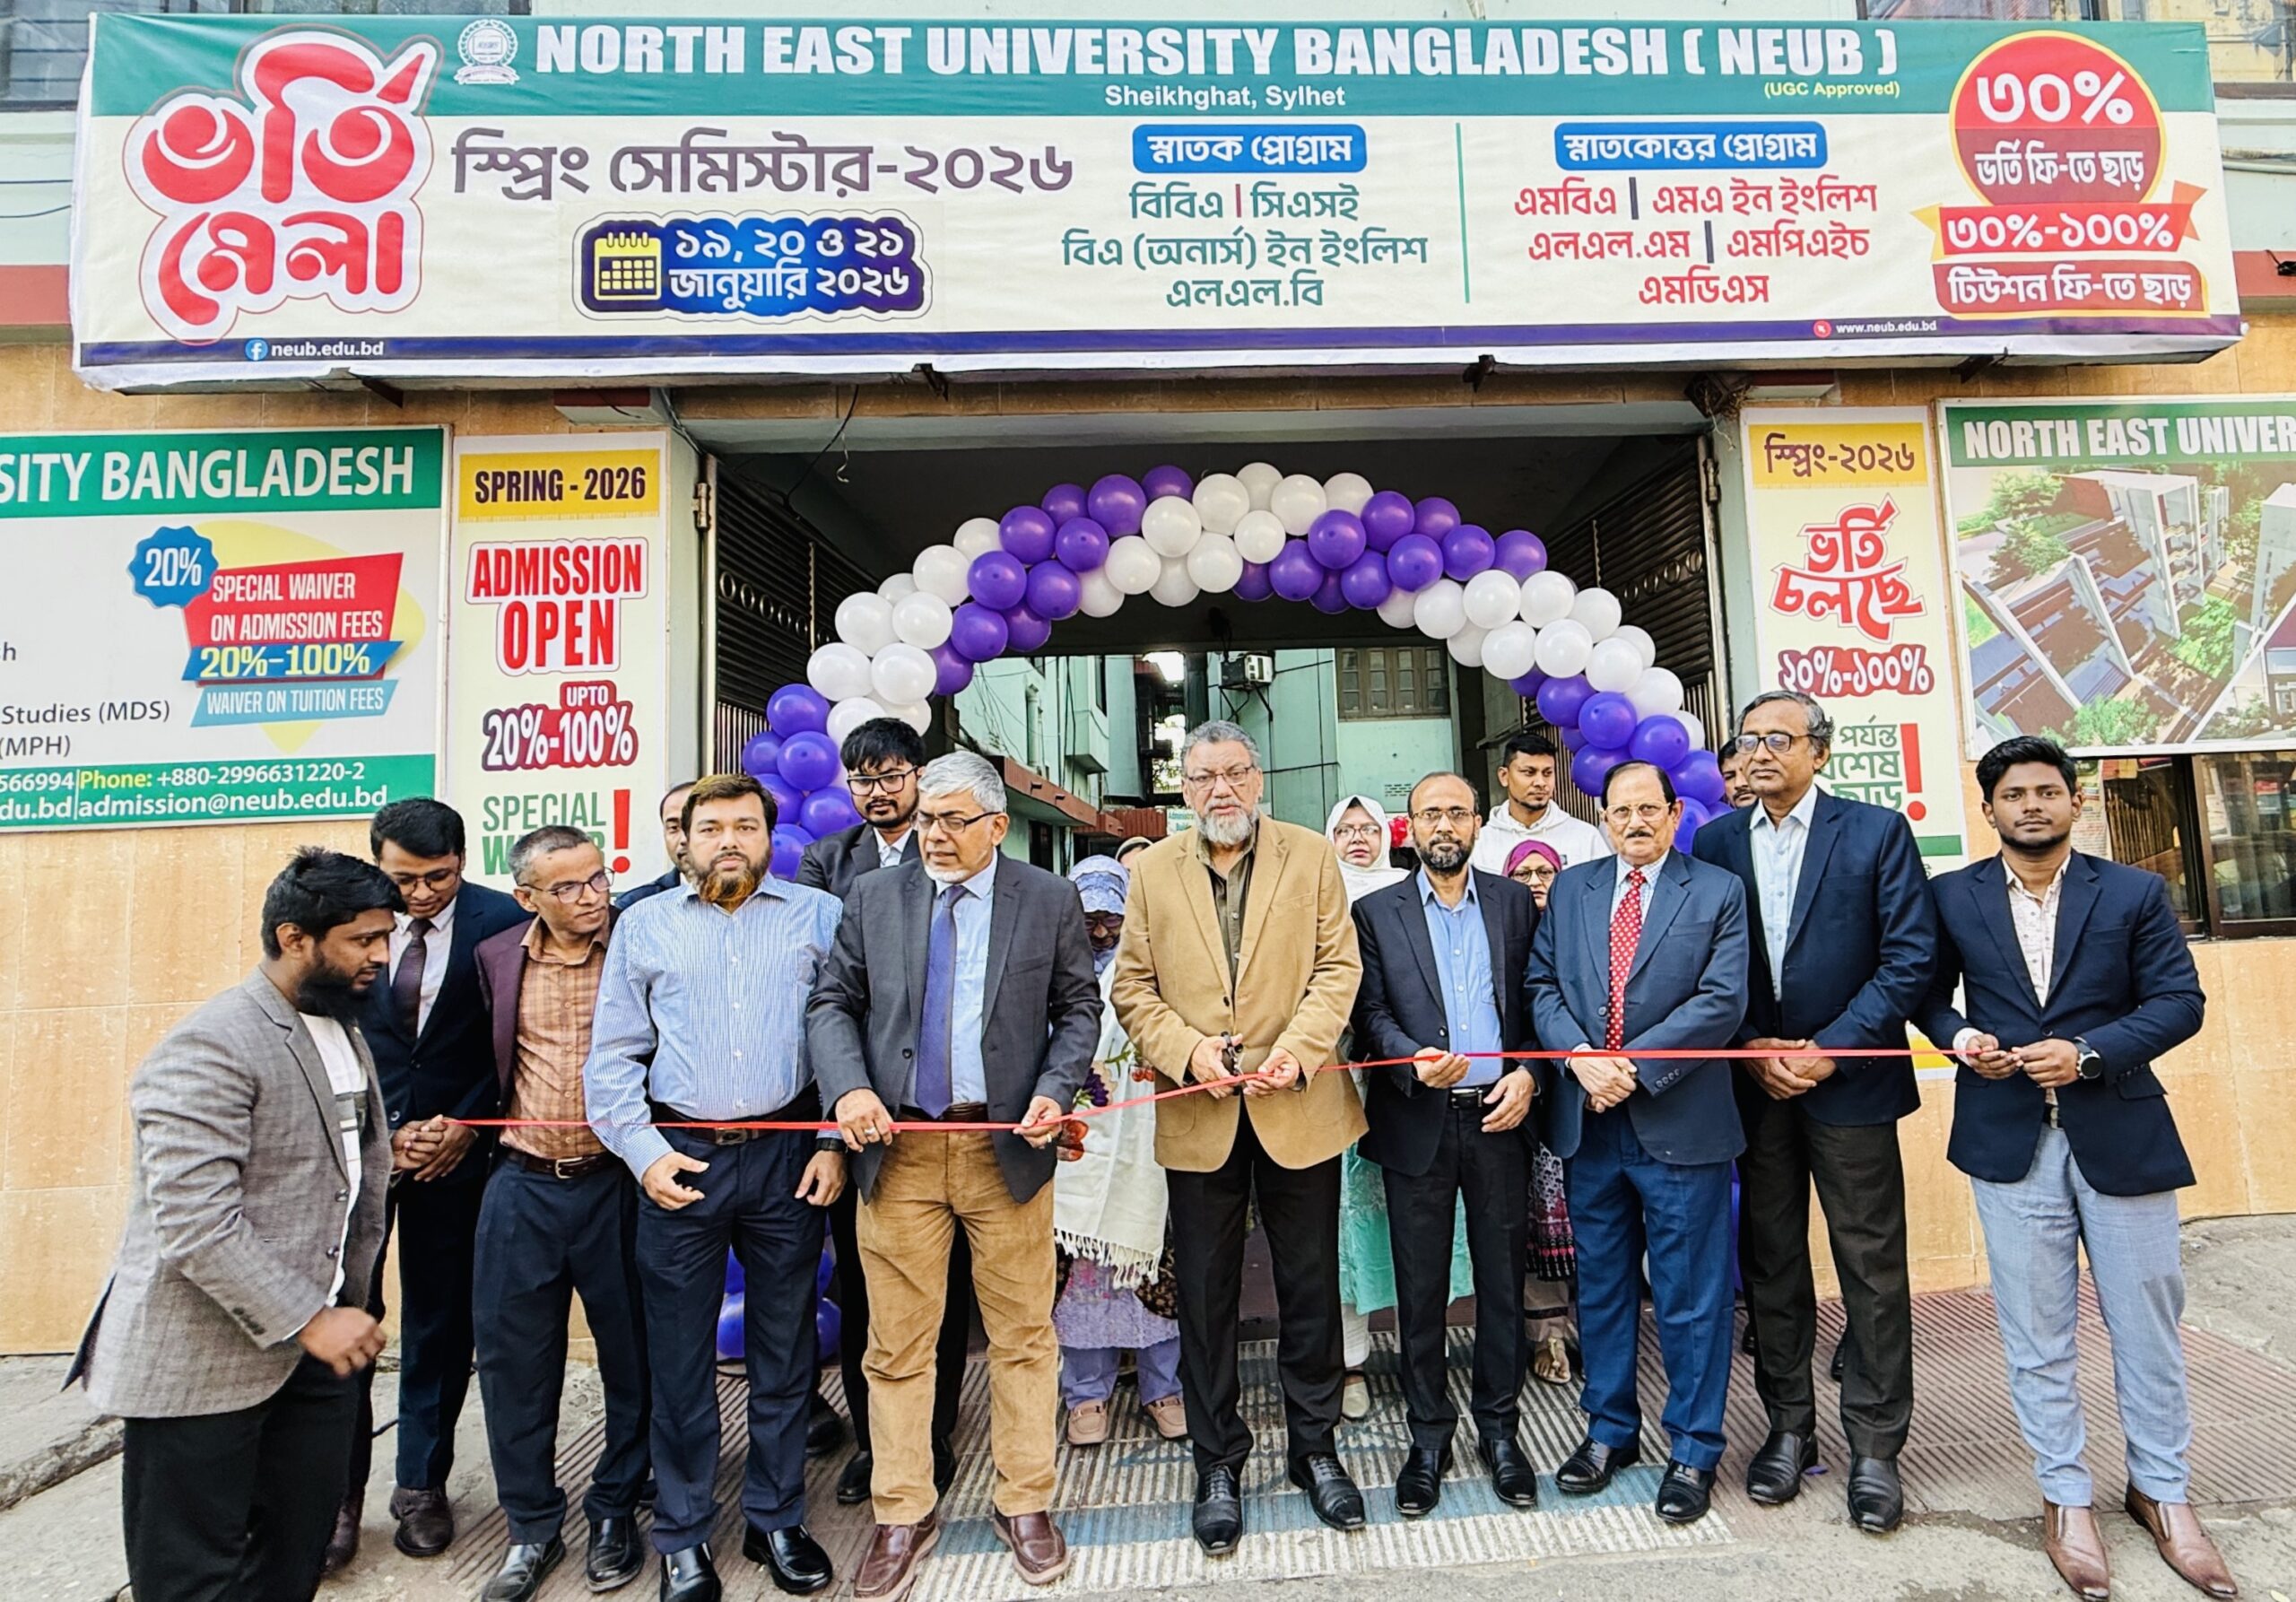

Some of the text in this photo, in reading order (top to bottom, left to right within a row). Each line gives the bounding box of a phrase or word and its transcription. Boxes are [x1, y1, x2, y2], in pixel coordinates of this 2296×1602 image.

[536, 25, 744, 75] NORTH
[763, 26, 912, 75] EAST
[926, 27, 1279, 76] UNIVERSITY
[1296, 28, 1671, 76] BANGLADESH
[1718, 28, 1866, 75] NEUB
[1105, 84, 1345, 109] Sheikhghat, Sylhet
[1764, 80, 1900, 100] (UGC Approved)
[1976, 70, 2134, 125] ৩০%
[142, 43, 425, 204] ভর্তি
[452, 126, 1073, 201] স্প্রিং সেমিস্টার-২০২৬
[1147, 135, 1352, 165] স্নাতক প্রোগ্রাম
[1563, 133, 1816, 161] স্নাতকোত্তর প্রোগ্রাম
[1975, 139, 2144, 191] ভর্তি ফি-তে ছাড়
[1129, 181, 1359, 221] বিবিএ সিএসই
[1514, 174, 1877, 216] এমবিএ এমএ ইন ইংলিশ
[676, 230, 903, 263] ১৯, ২০ ও ২১
[1062, 225, 1428, 270] বিএ (অনার্স) ইন ইংলিশ
[1528, 219, 1870, 260] এলএল.এম এমপিএইচ
[1947, 213, 2174, 248] ৩০%-১০০%
[159, 211, 404, 326] মেলা
[669, 257, 909, 309] জানুয়ারি ২০২৬
[1166, 268, 1324, 307] এলএল.বি
[1639, 265, 1770, 304] এমডিএস
[1948, 264, 2192, 309] টিউশন ফি-তে ছাড়
[1836, 320, 1937, 335] www.neub.edu.bd
[271, 339, 384, 358] neub.edu.bd
[1764, 432, 1915, 477] স্প্রিং-২০২৬
[1964, 415, 2296, 459] NORTH EAST UNIVER
[102, 446, 414, 501] BANGLADESH
[474, 469, 564, 503] SPRING
[584, 466, 646, 501] 2026
[1805, 501, 1895, 572] ভর্তি
[144, 547, 202, 587] 20%
[472, 544, 642, 598] ADMISSION
[213, 572, 356, 603] SPECIAL WAIVER
[1774, 563, 1923, 640] চলছে
[211, 610, 383, 641] ON ADMISSION FEES
[503, 598, 614, 670] OPEN
[1, 700, 170, 725] Studies (MDS)
[207, 687, 384, 716] WAIVER ON TUITION FEES
[566, 684, 609, 708] UPTO
[0, 735, 71, 760] (MPH)
[487, 705, 634, 766] 20%-100%
[1839, 715, 1897, 747] পর্যন্ত
[79, 770, 152, 789] Phone:
[156, 762, 365, 787] +880-2996631220-2
[78, 785, 387, 818] admission@neub.edu.bd
[483, 792, 606, 832] SPECIAL
